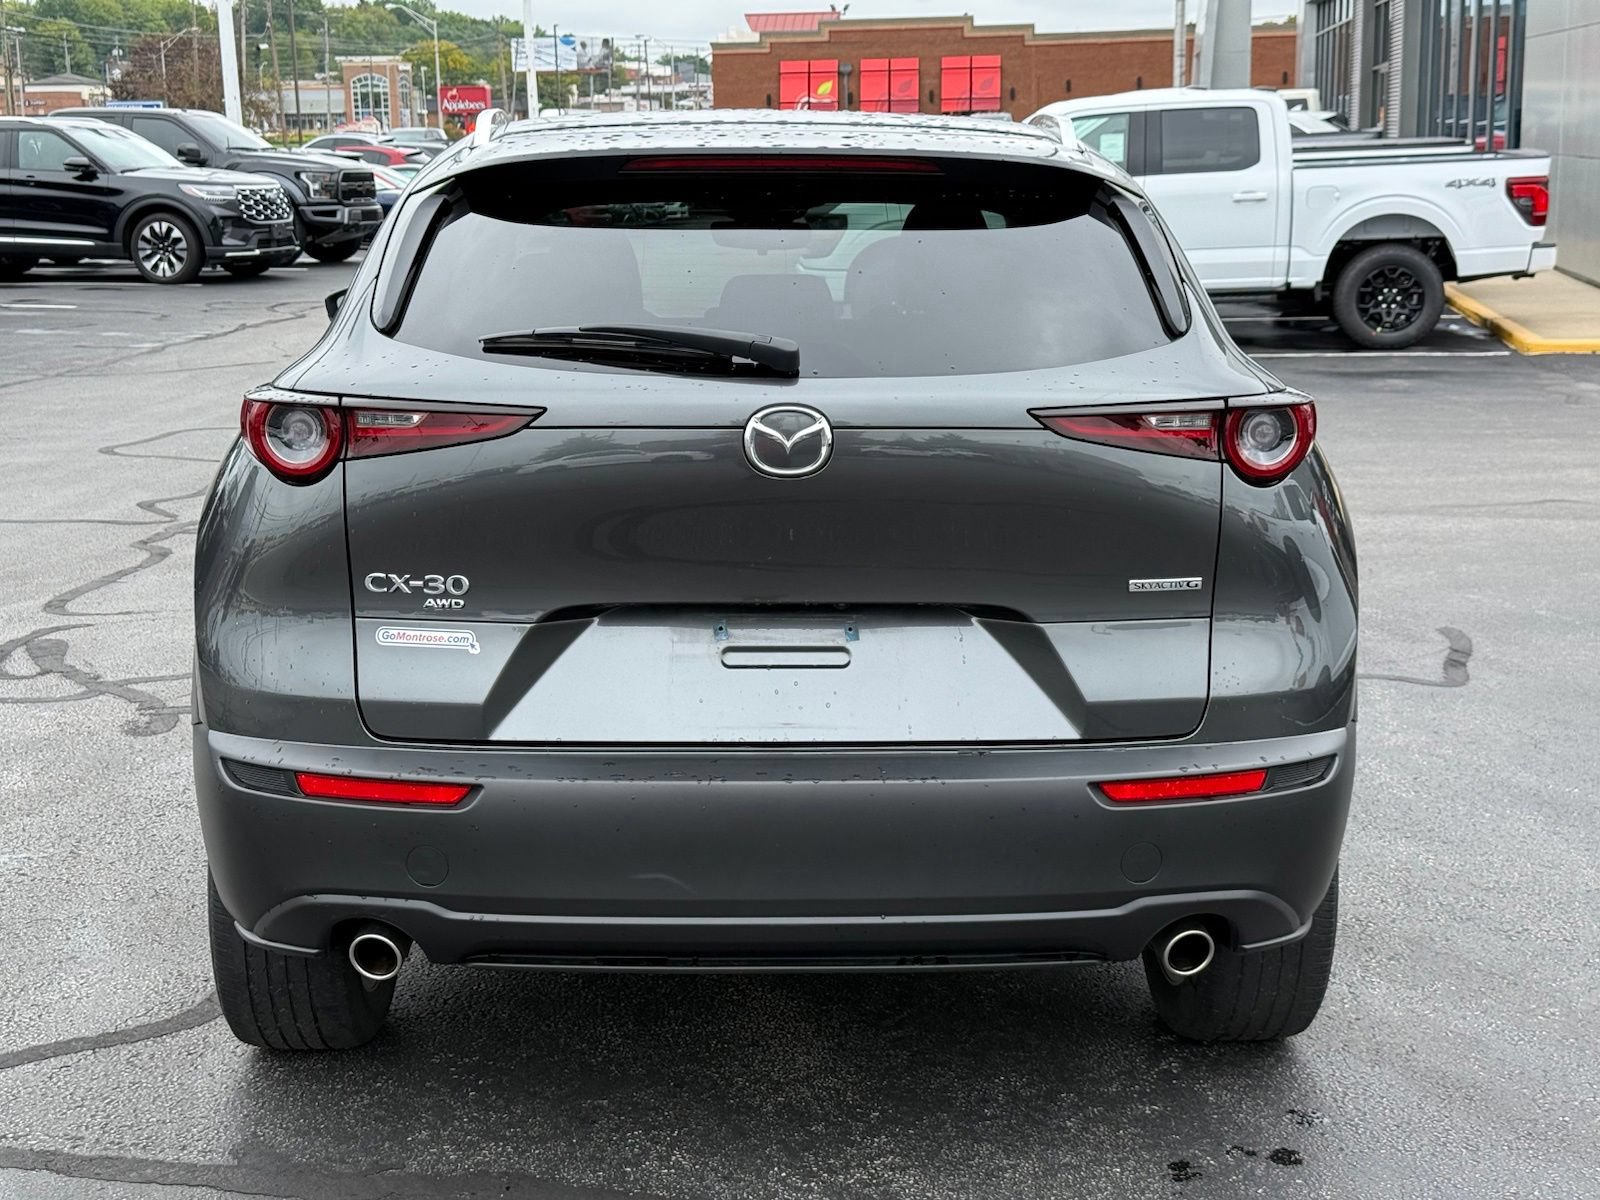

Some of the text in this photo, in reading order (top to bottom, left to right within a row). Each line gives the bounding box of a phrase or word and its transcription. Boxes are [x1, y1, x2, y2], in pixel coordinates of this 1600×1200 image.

[364, 572, 470, 596] CX-30
[423, 598, 465, 610] AWD
[381, 630, 470, 645] GoMontrose.com
